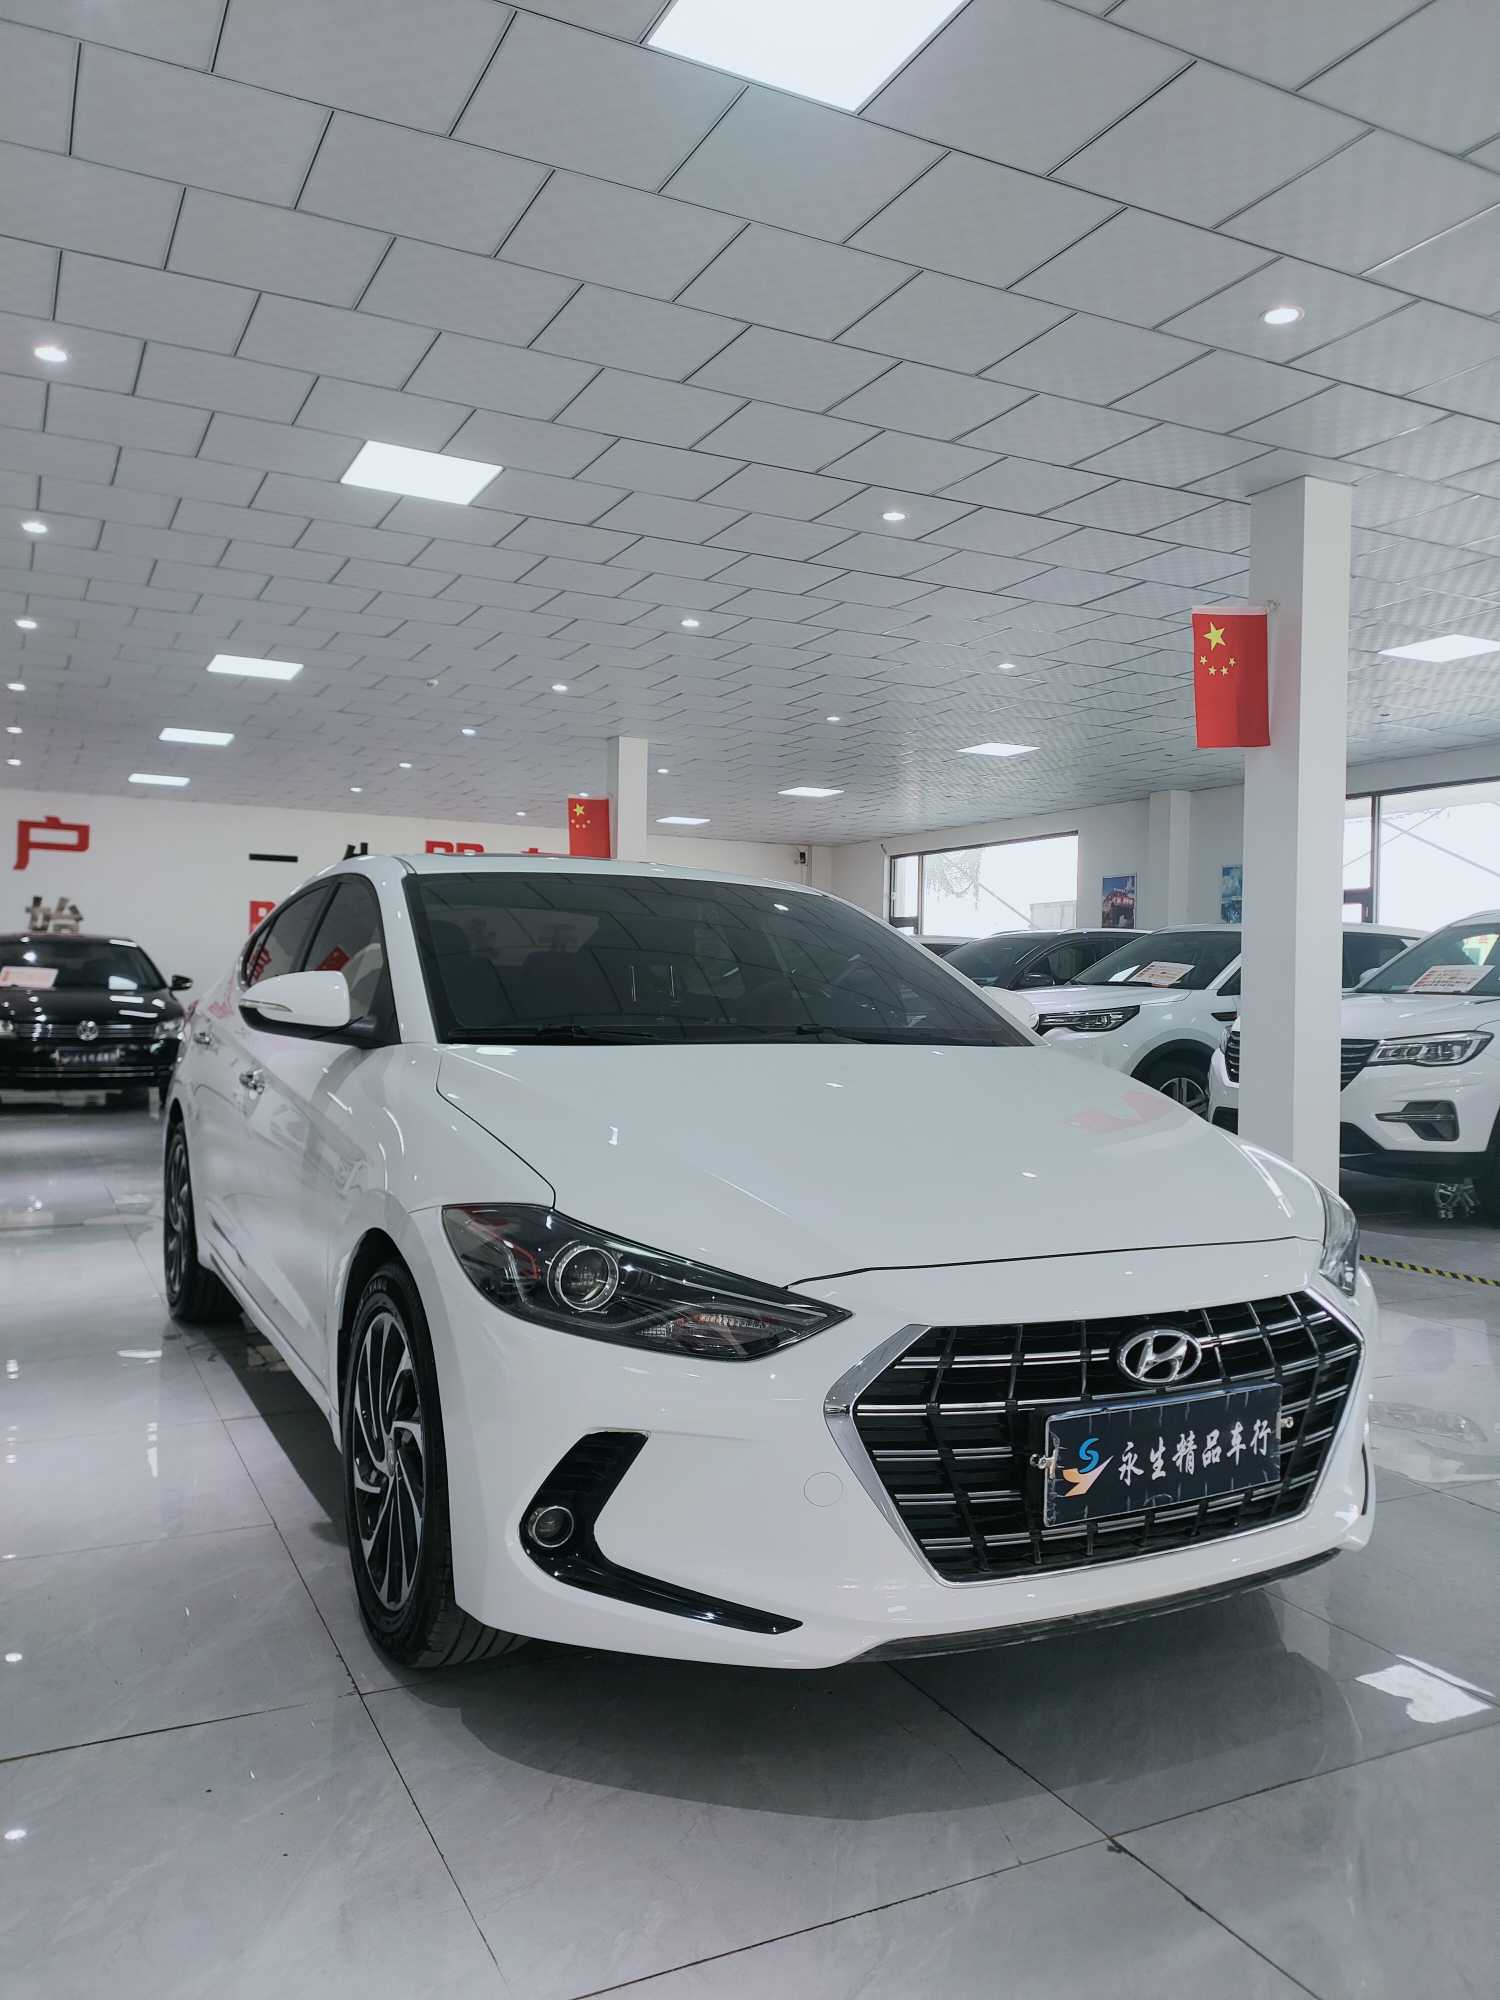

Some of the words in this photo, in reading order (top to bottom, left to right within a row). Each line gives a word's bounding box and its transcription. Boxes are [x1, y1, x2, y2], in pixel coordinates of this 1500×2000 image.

[13, 816, 90, 870] 户
[1117, 1418, 1272, 1487] 永生精品车行
